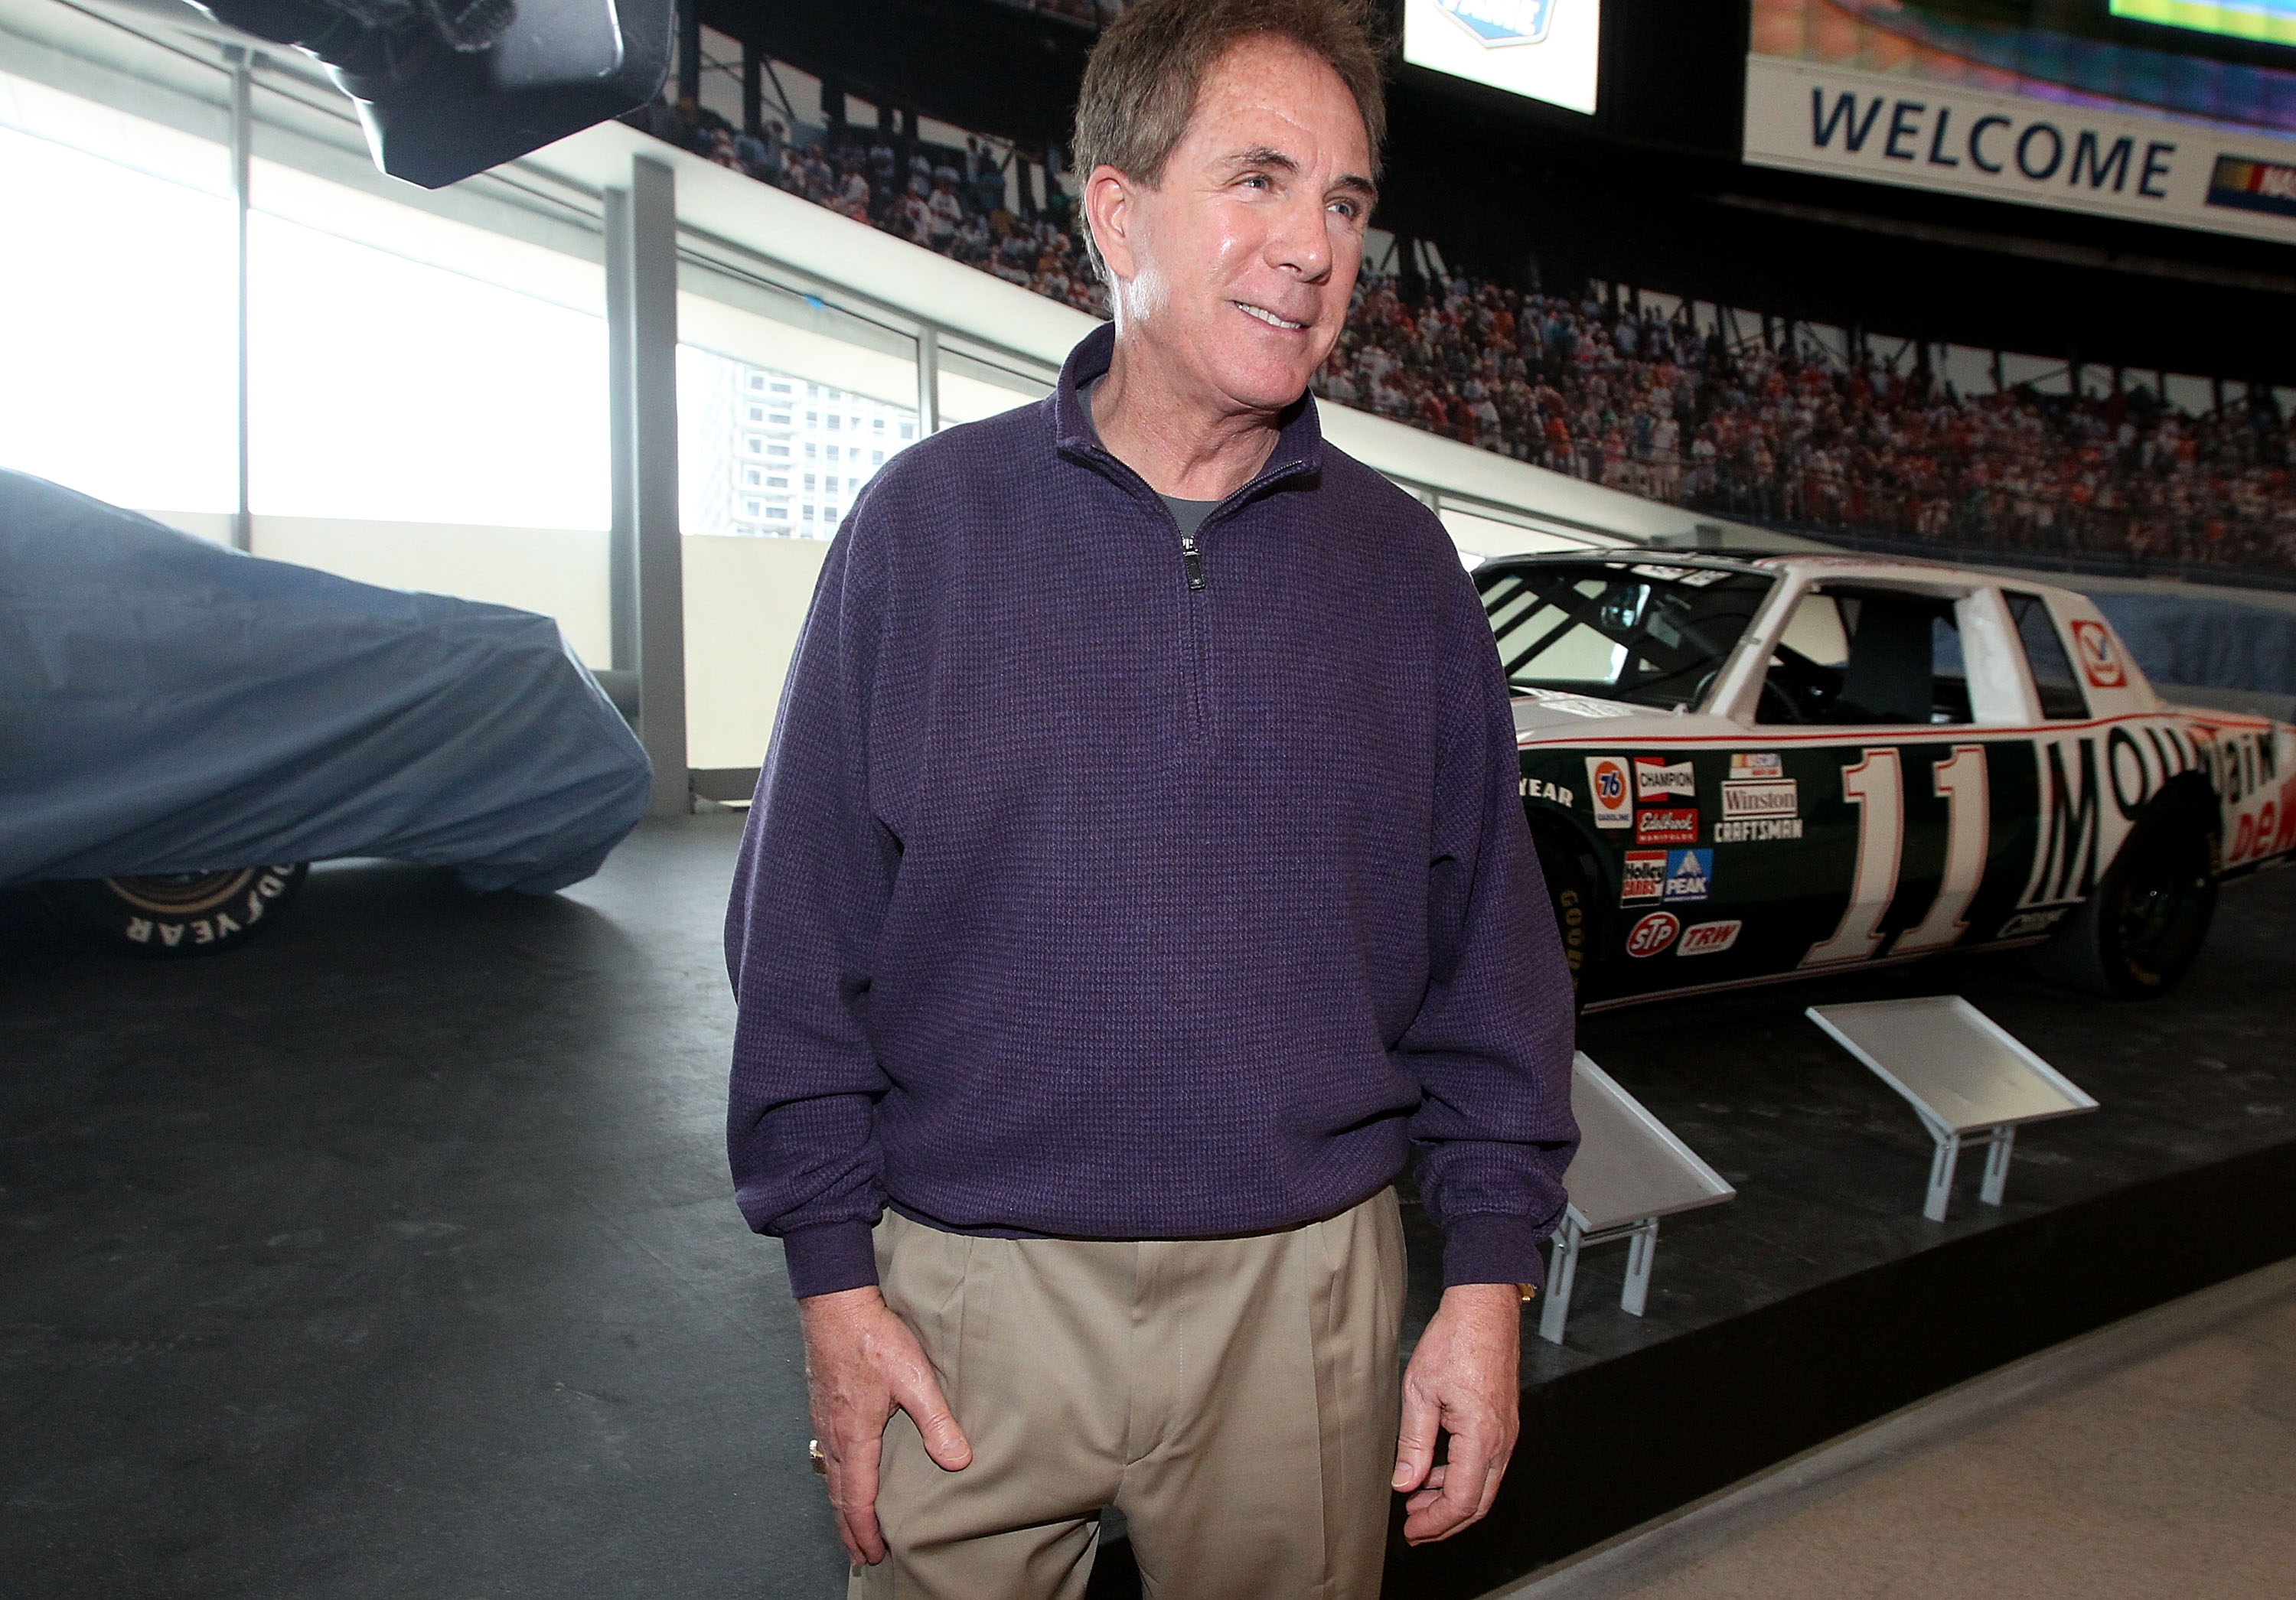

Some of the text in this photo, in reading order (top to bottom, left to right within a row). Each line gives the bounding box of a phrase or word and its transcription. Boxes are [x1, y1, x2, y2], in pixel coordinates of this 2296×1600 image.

[1810, 87, 2175, 199] WELCOME
[1598, 771, 1621, 797] 76
[1639, 771, 1694, 788] CHAMPION
[1725, 789, 1795, 811] Winston
[1639, 811, 1694, 833] Edelbrock
[1714, 819, 1803, 843] CRAFTSMAN
[1799, 745, 1990, 967] 11
[1623, 862, 1665, 884] Holley
[1665, 877, 1708, 895] PEAK
[1631, 918, 1673, 951] STP
[1684, 925, 1738, 948] TRW
